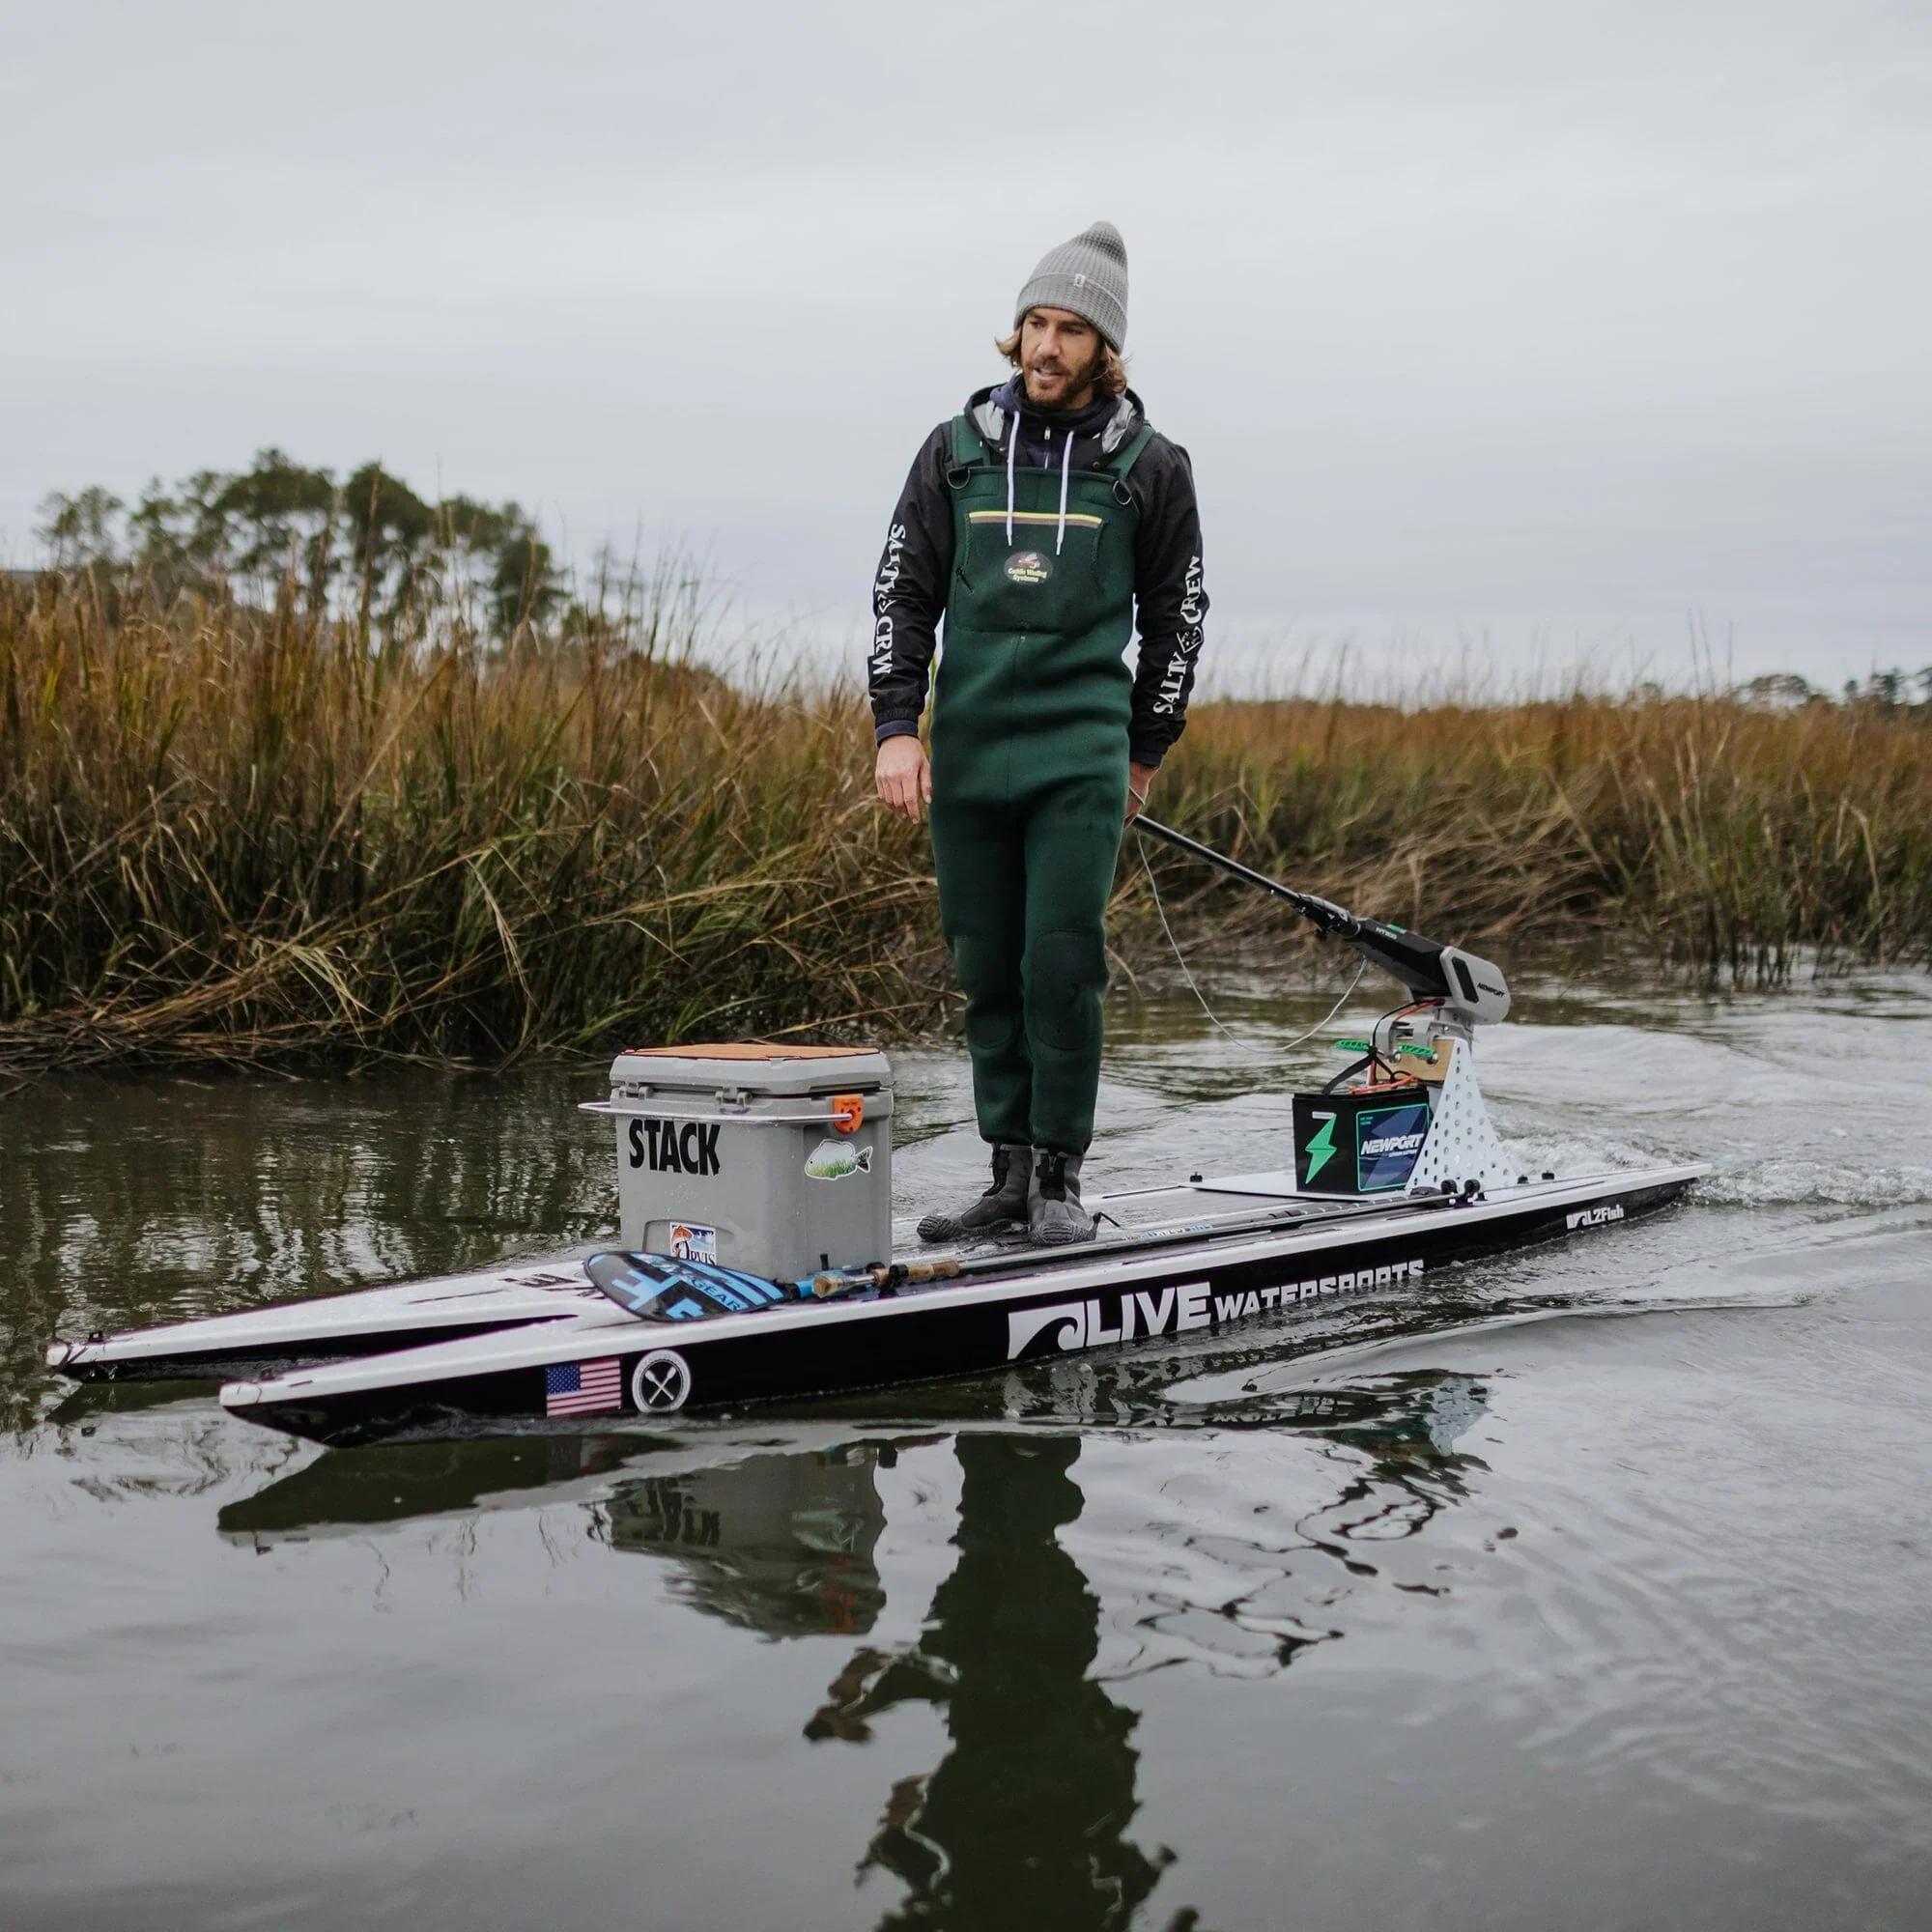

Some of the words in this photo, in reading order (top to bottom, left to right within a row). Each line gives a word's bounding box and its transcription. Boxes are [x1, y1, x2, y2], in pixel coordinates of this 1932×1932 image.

[875, 524, 906, 593] SALTY
[1180, 555, 1203, 625] CREW
[872, 615, 894, 675] CRW
[1152, 651, 1189, 715] SALTY
[1476, 981, 1505, 998] NEWPORT
[628, 1119, 721, 1177] STACK
[1360, 1133, 1425, 1155] NEWPORT
[691, 1278, 742, 1312] GEAR
[1085, 1280, 1213, 1349] LIVE
[1214, 1259, 1425, 1322] WATERSPORTS
